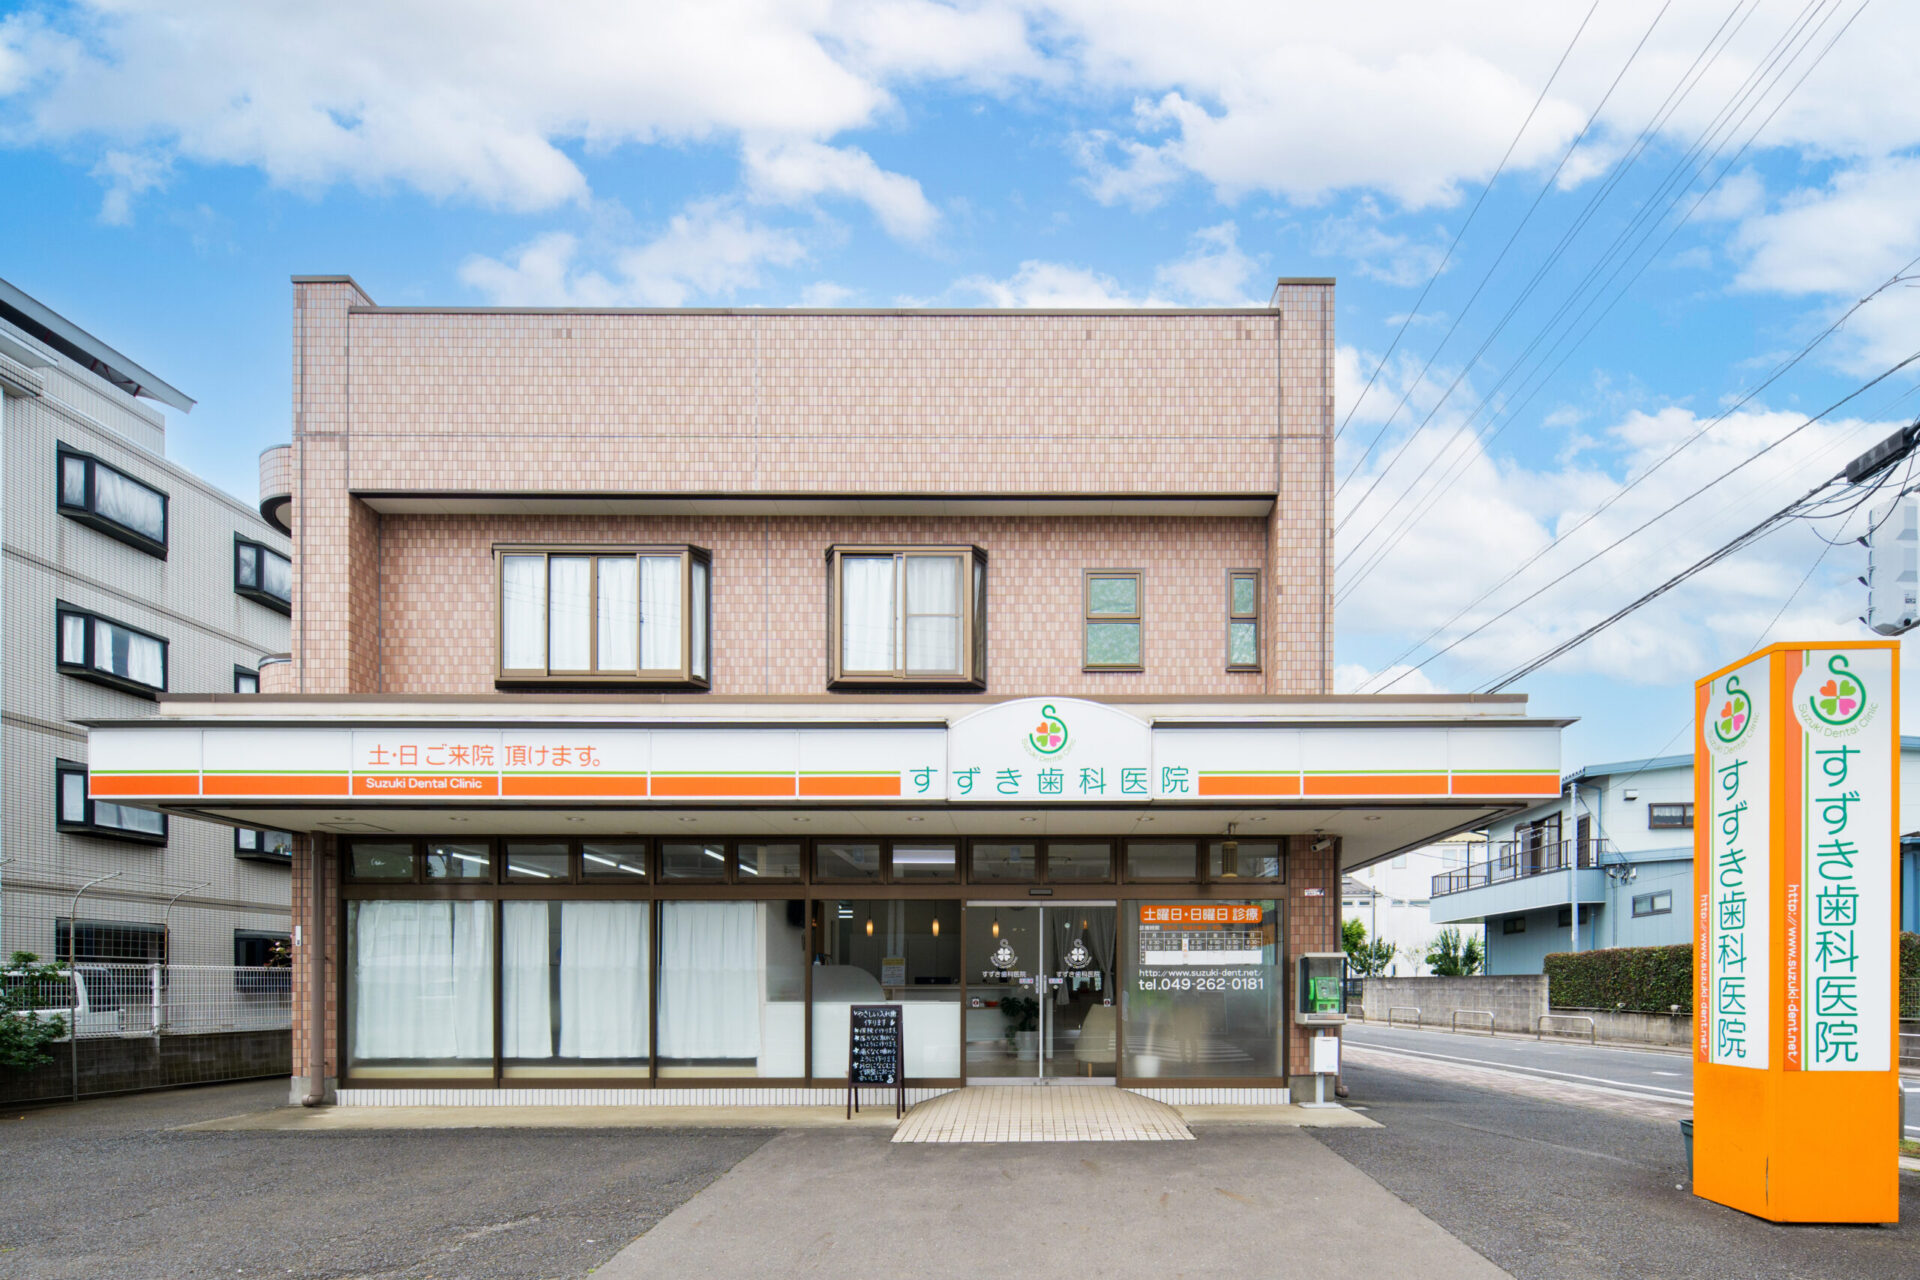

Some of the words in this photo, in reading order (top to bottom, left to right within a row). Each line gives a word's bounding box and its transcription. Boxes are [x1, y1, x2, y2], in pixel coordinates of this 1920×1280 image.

[1798, 703, 1823, 734] Suzuki
[1824, 726, 1859, 738] Dental
[1859, 702, 1879, 728] Clinic
[366, 777, 406, 789] Suzuki
[408, 777, 448, 789] Dental
[450, 777, 483, 789] Clinic
[909, 766, 1190, 796] すずき歯科医院
[1717, 758, 1748, 1059] すずき歯科医院
[1816, 744, 1861, 1063] すずき歯科医院
[1138, 978, 1264, 990] tel.049-262-0181
[1139, 969, 1263, 977] http://www.suzuki-dent.net/
[1699, 894, 1710, 1056] http://www.suzuki-dent.net/
[1787, 884, 1800, 1064] http://www.suzuki-dent.net/
